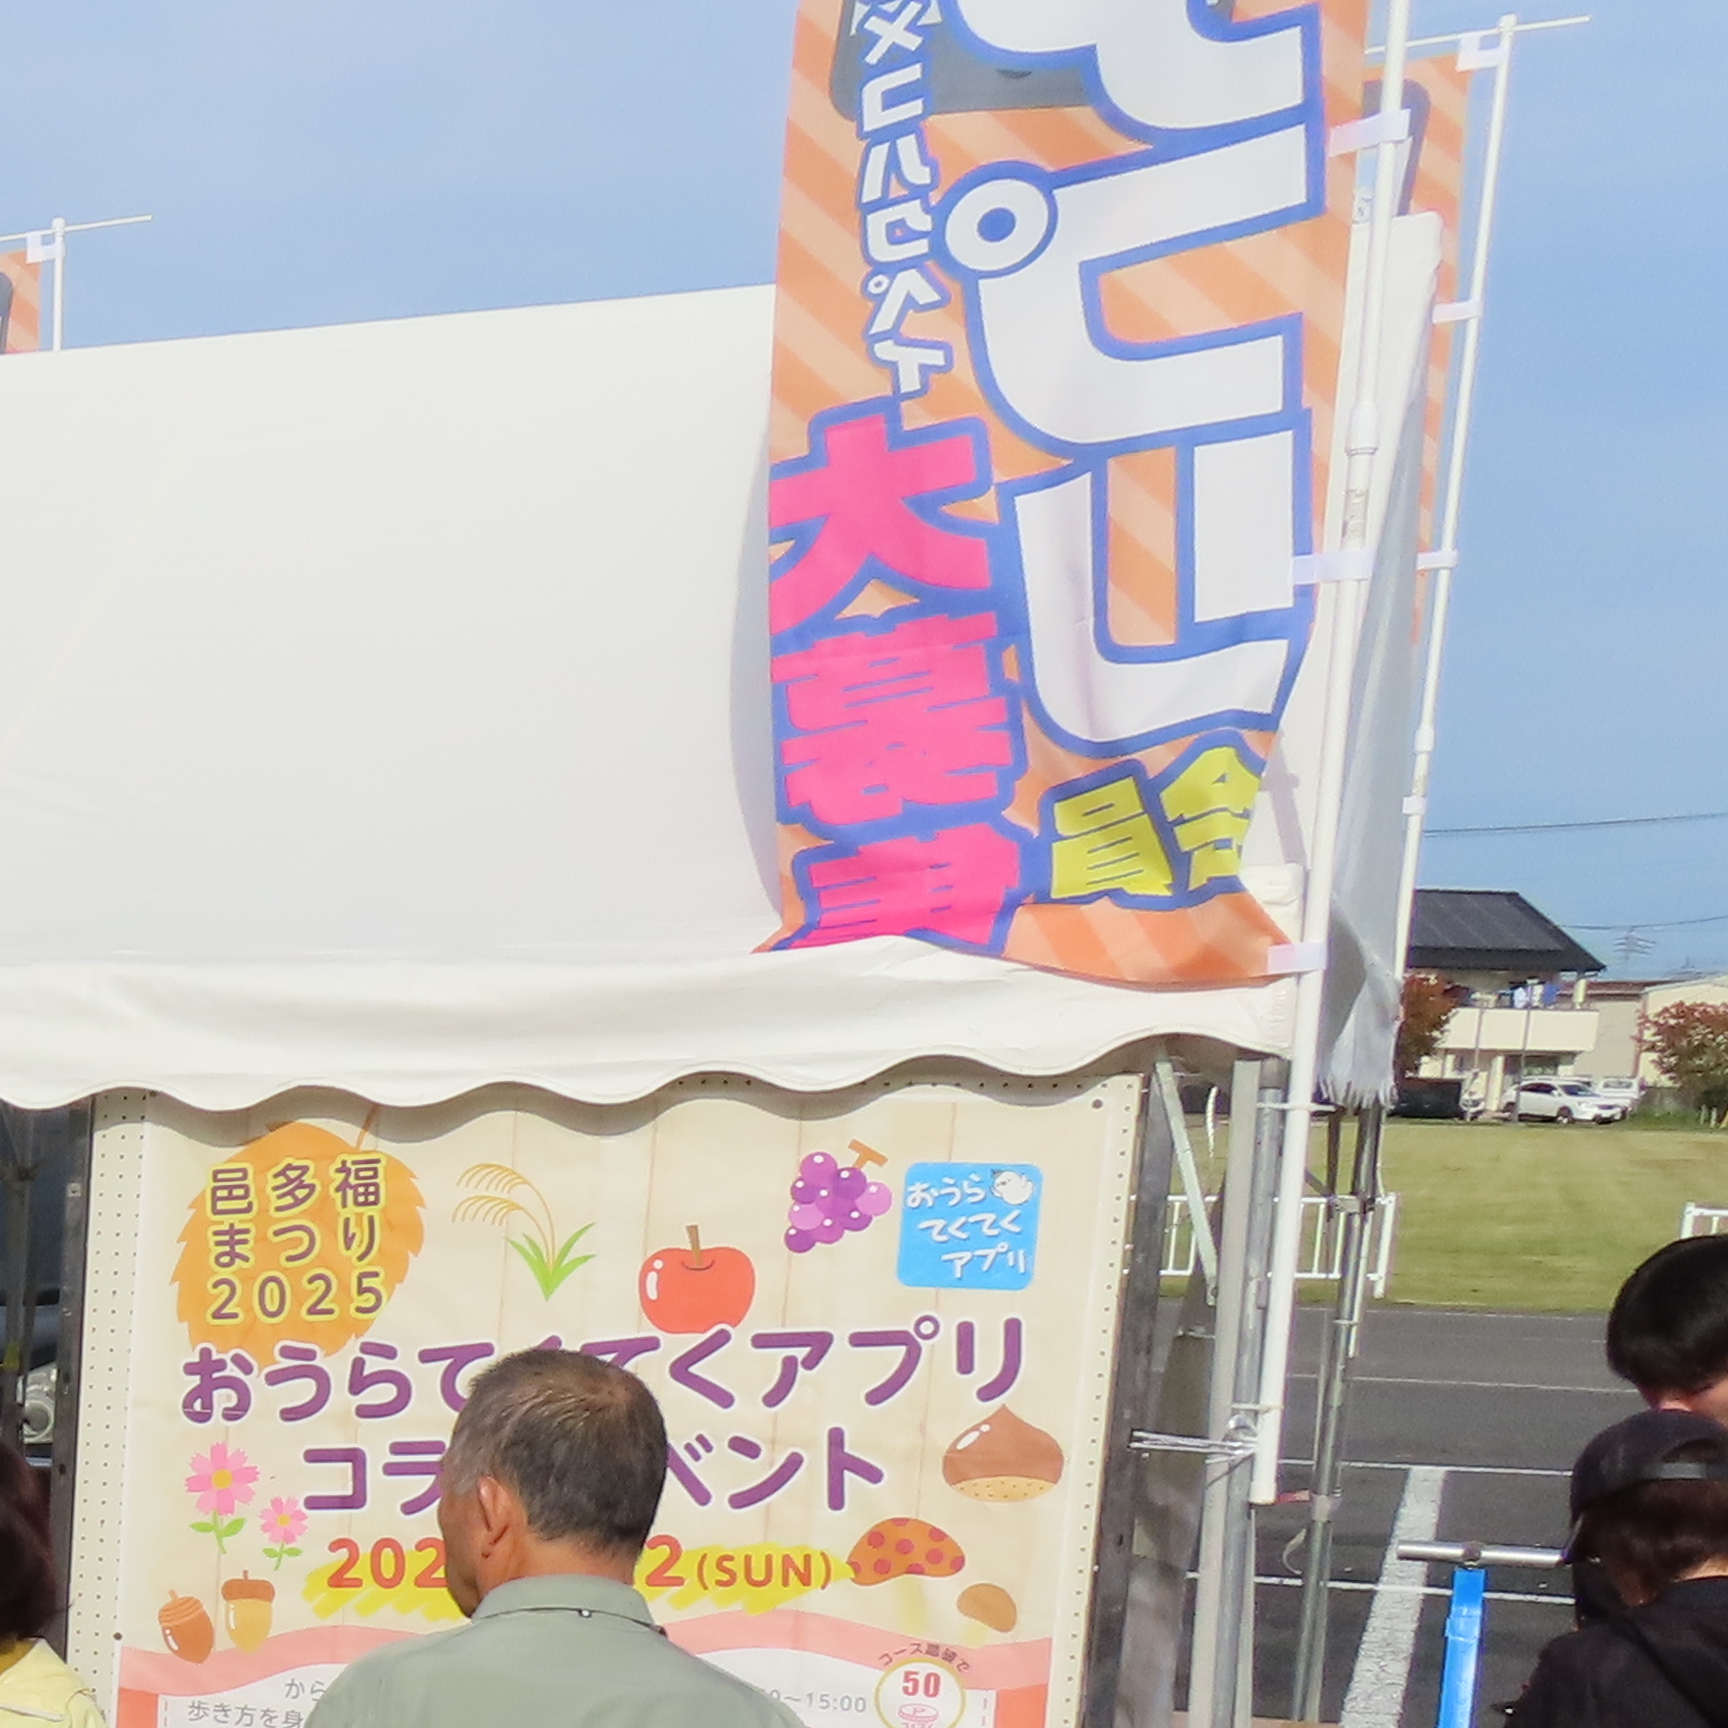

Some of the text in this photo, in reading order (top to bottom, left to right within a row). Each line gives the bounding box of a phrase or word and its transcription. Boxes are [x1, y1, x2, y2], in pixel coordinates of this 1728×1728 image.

[210, 1157, 382, 1216] 邑多福
[906, 1172, 986, 1209] おうら
[211, 1214, 377, 1268] まつり
[917, 1209, 1023, 1243] てくてく
[941, 1242, 1027, 1279] アプリ
[210, 1271, 384, 1320] 2025
[302, 1425, 885, 1515] コラベント
[902, 1670, 941, 1698] 50
